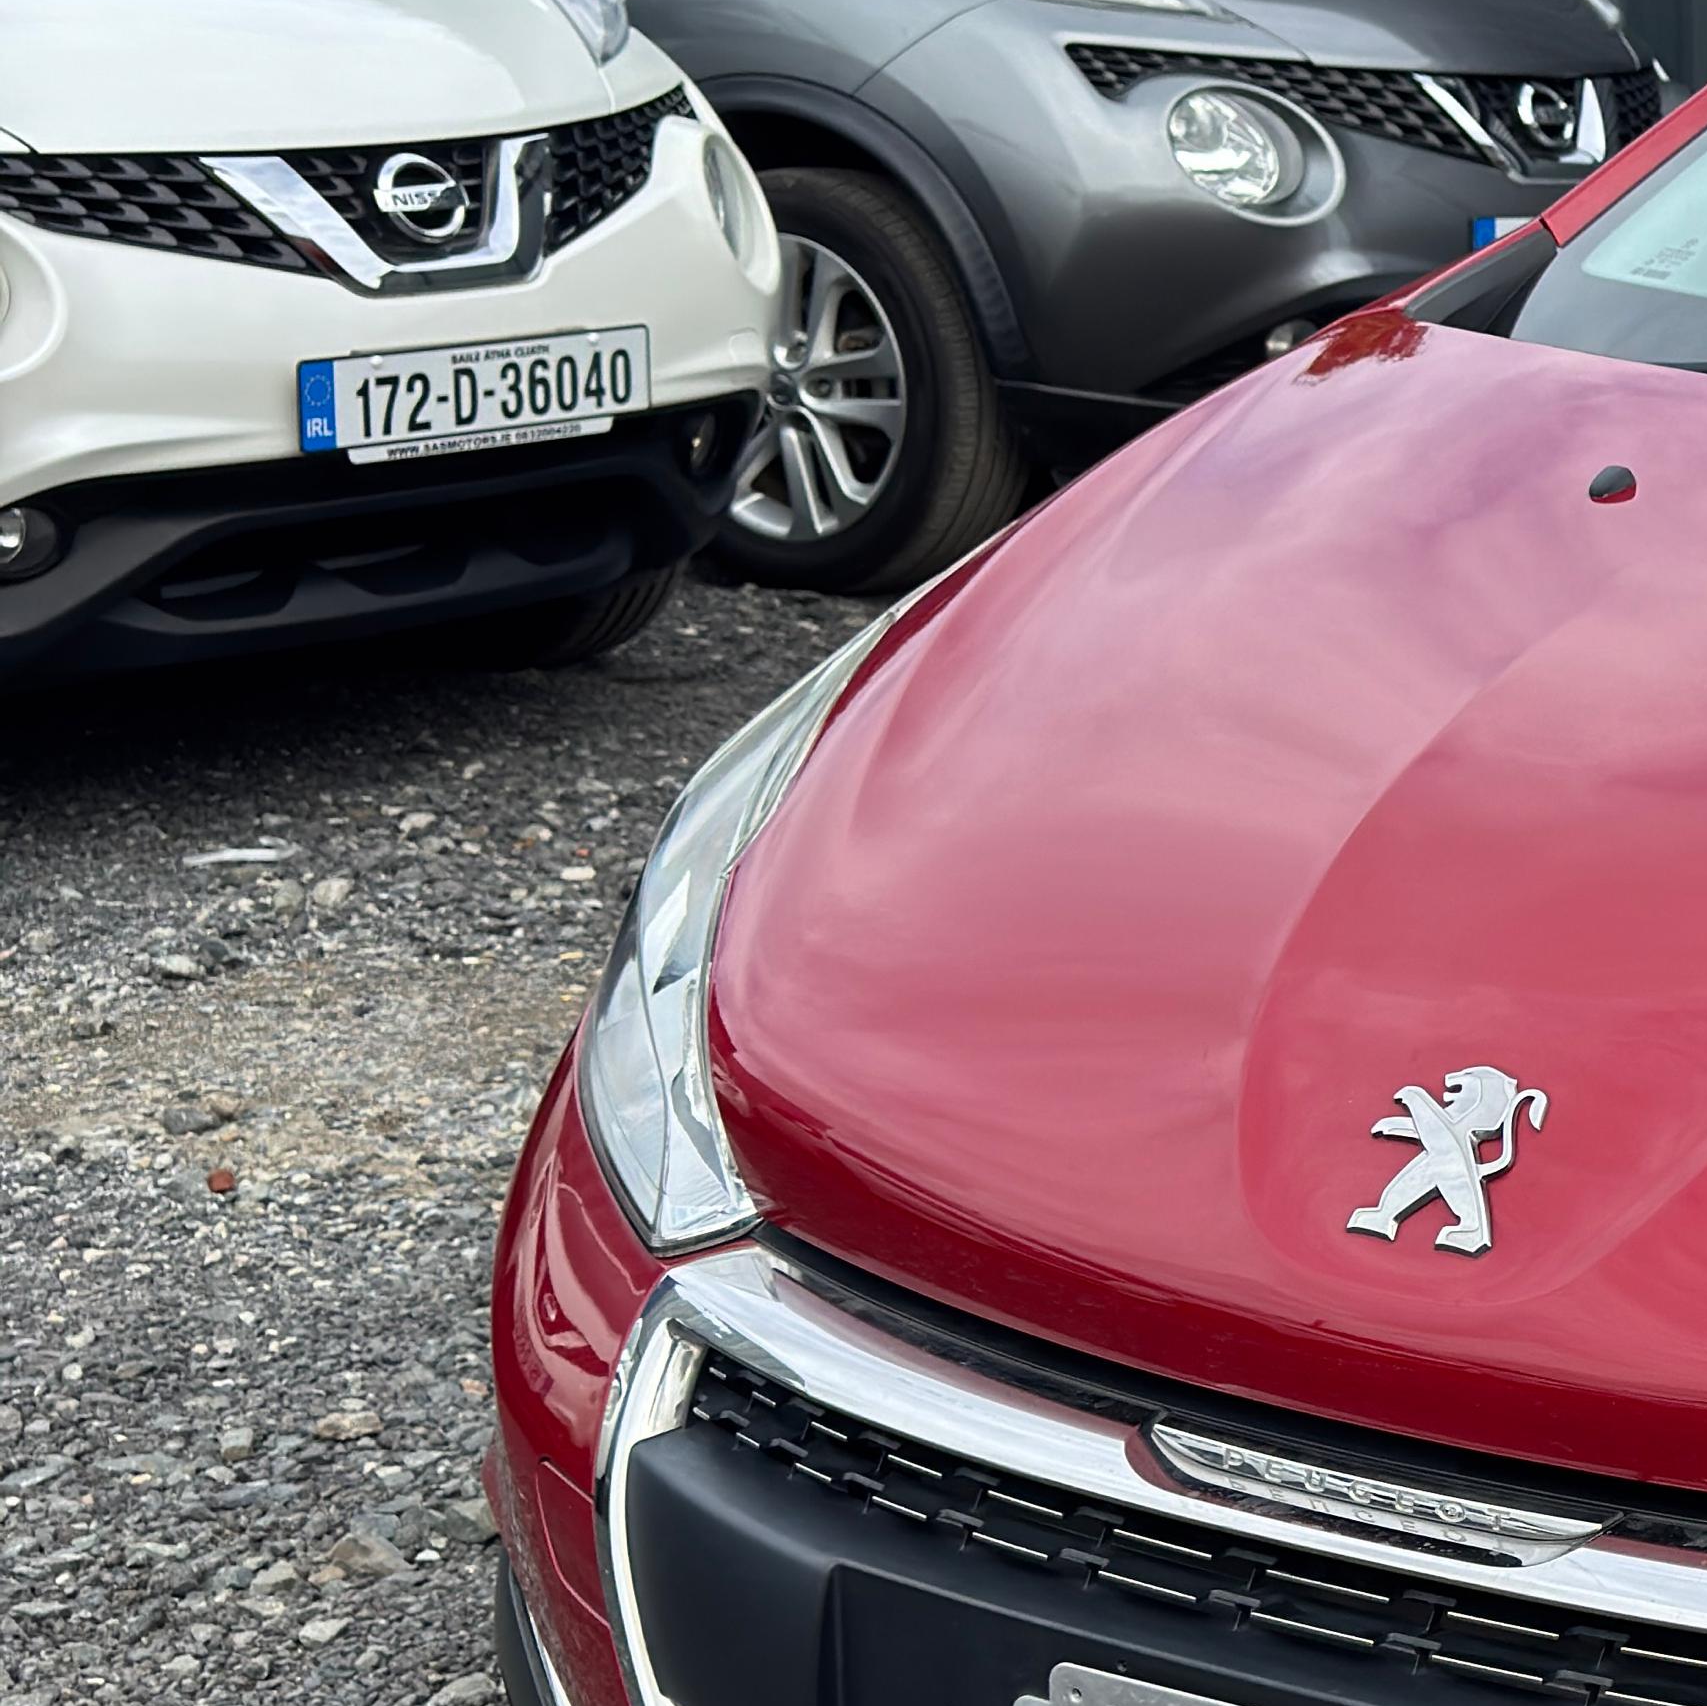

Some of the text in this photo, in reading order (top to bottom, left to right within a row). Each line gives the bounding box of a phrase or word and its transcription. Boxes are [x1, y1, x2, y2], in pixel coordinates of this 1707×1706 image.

[306, 417, 334, 438] IRL
[355, 348, 632, 439] 172-D-36040
[1221, 1446, 1514, 1533] PEUGEOT
